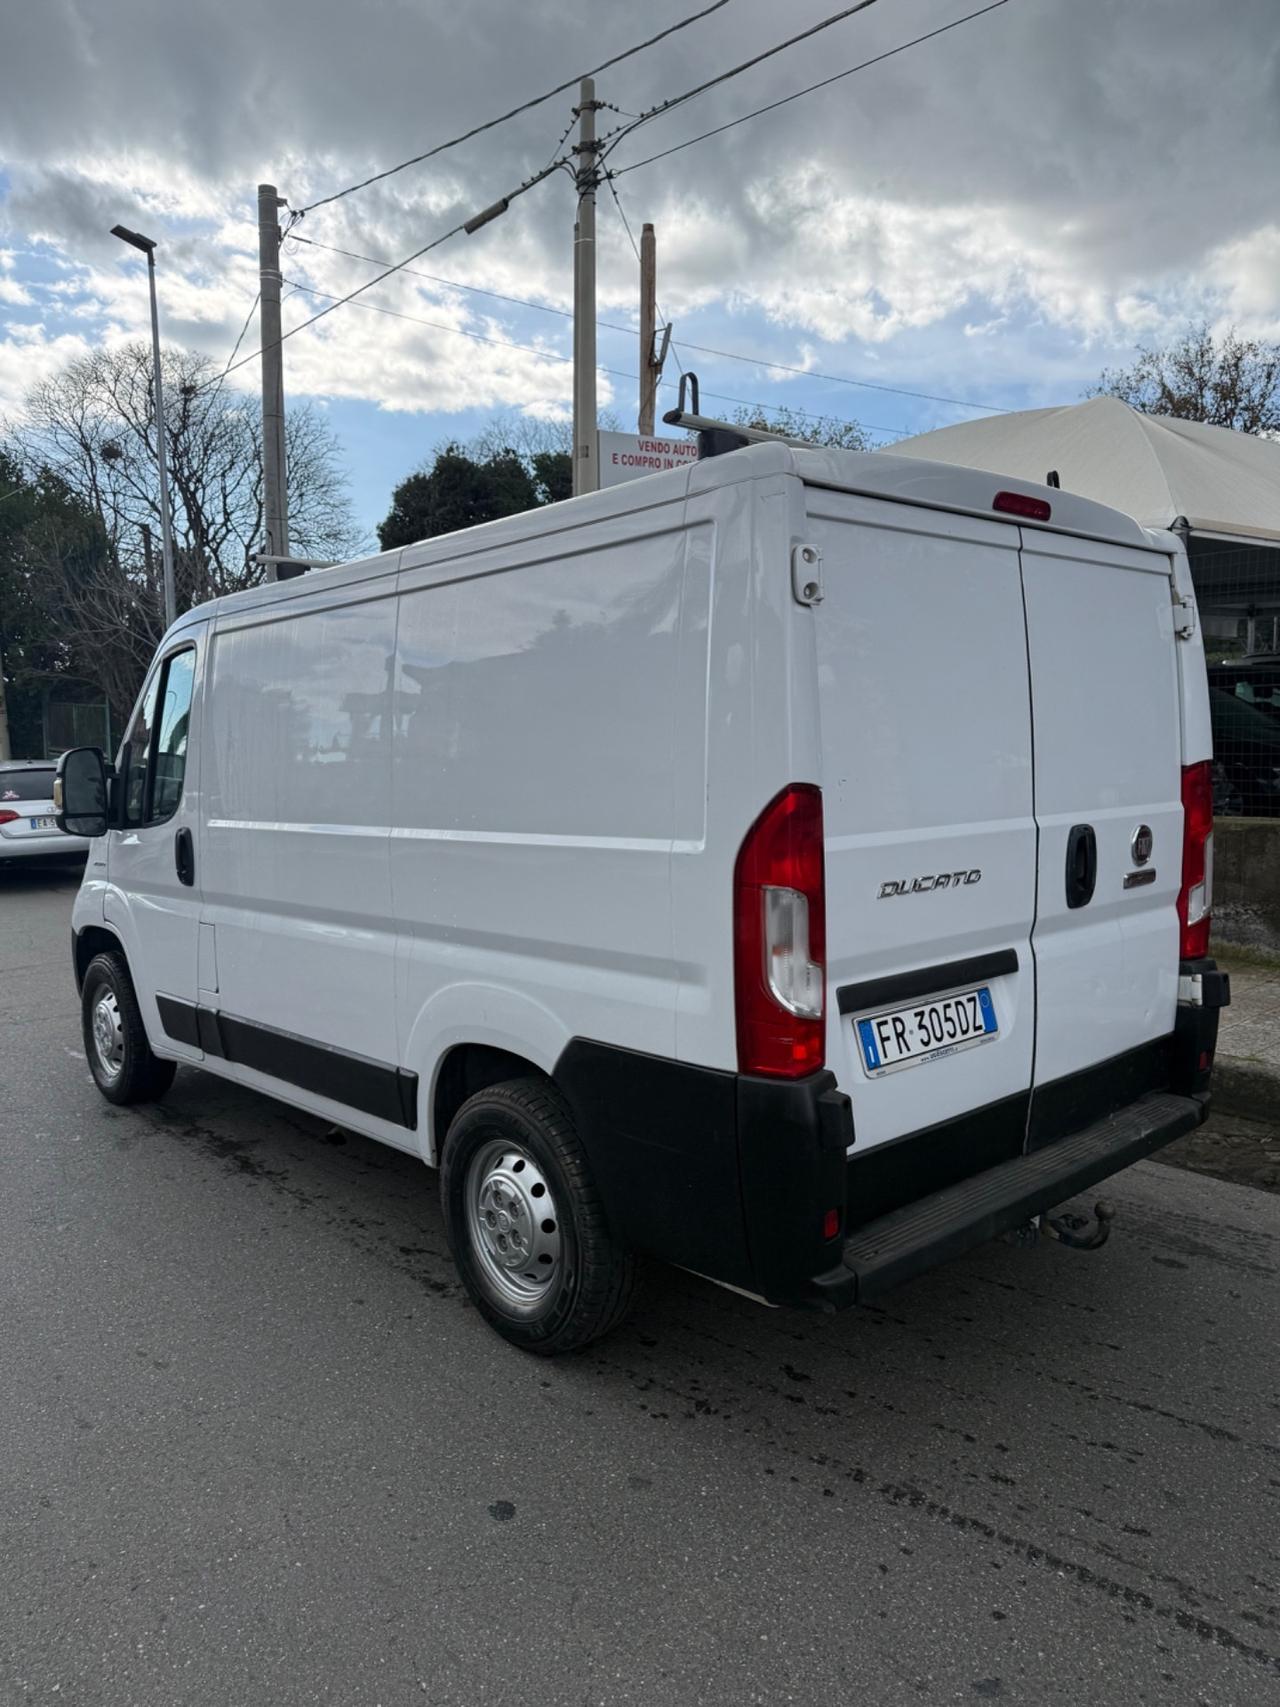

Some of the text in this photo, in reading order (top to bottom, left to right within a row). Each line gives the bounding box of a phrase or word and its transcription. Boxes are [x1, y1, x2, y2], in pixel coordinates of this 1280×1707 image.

[638, 440, 670, 454] VENDO
[612, 453, 618, 465] E
[621, 454, 661, 469] COMPRO
[664, 458, 673, 469] IN
[878, 869, 982, 899] DUCATO
[876, 1016, 911, 1059] FR
[914, 996, 983, 1047] 305DZ
